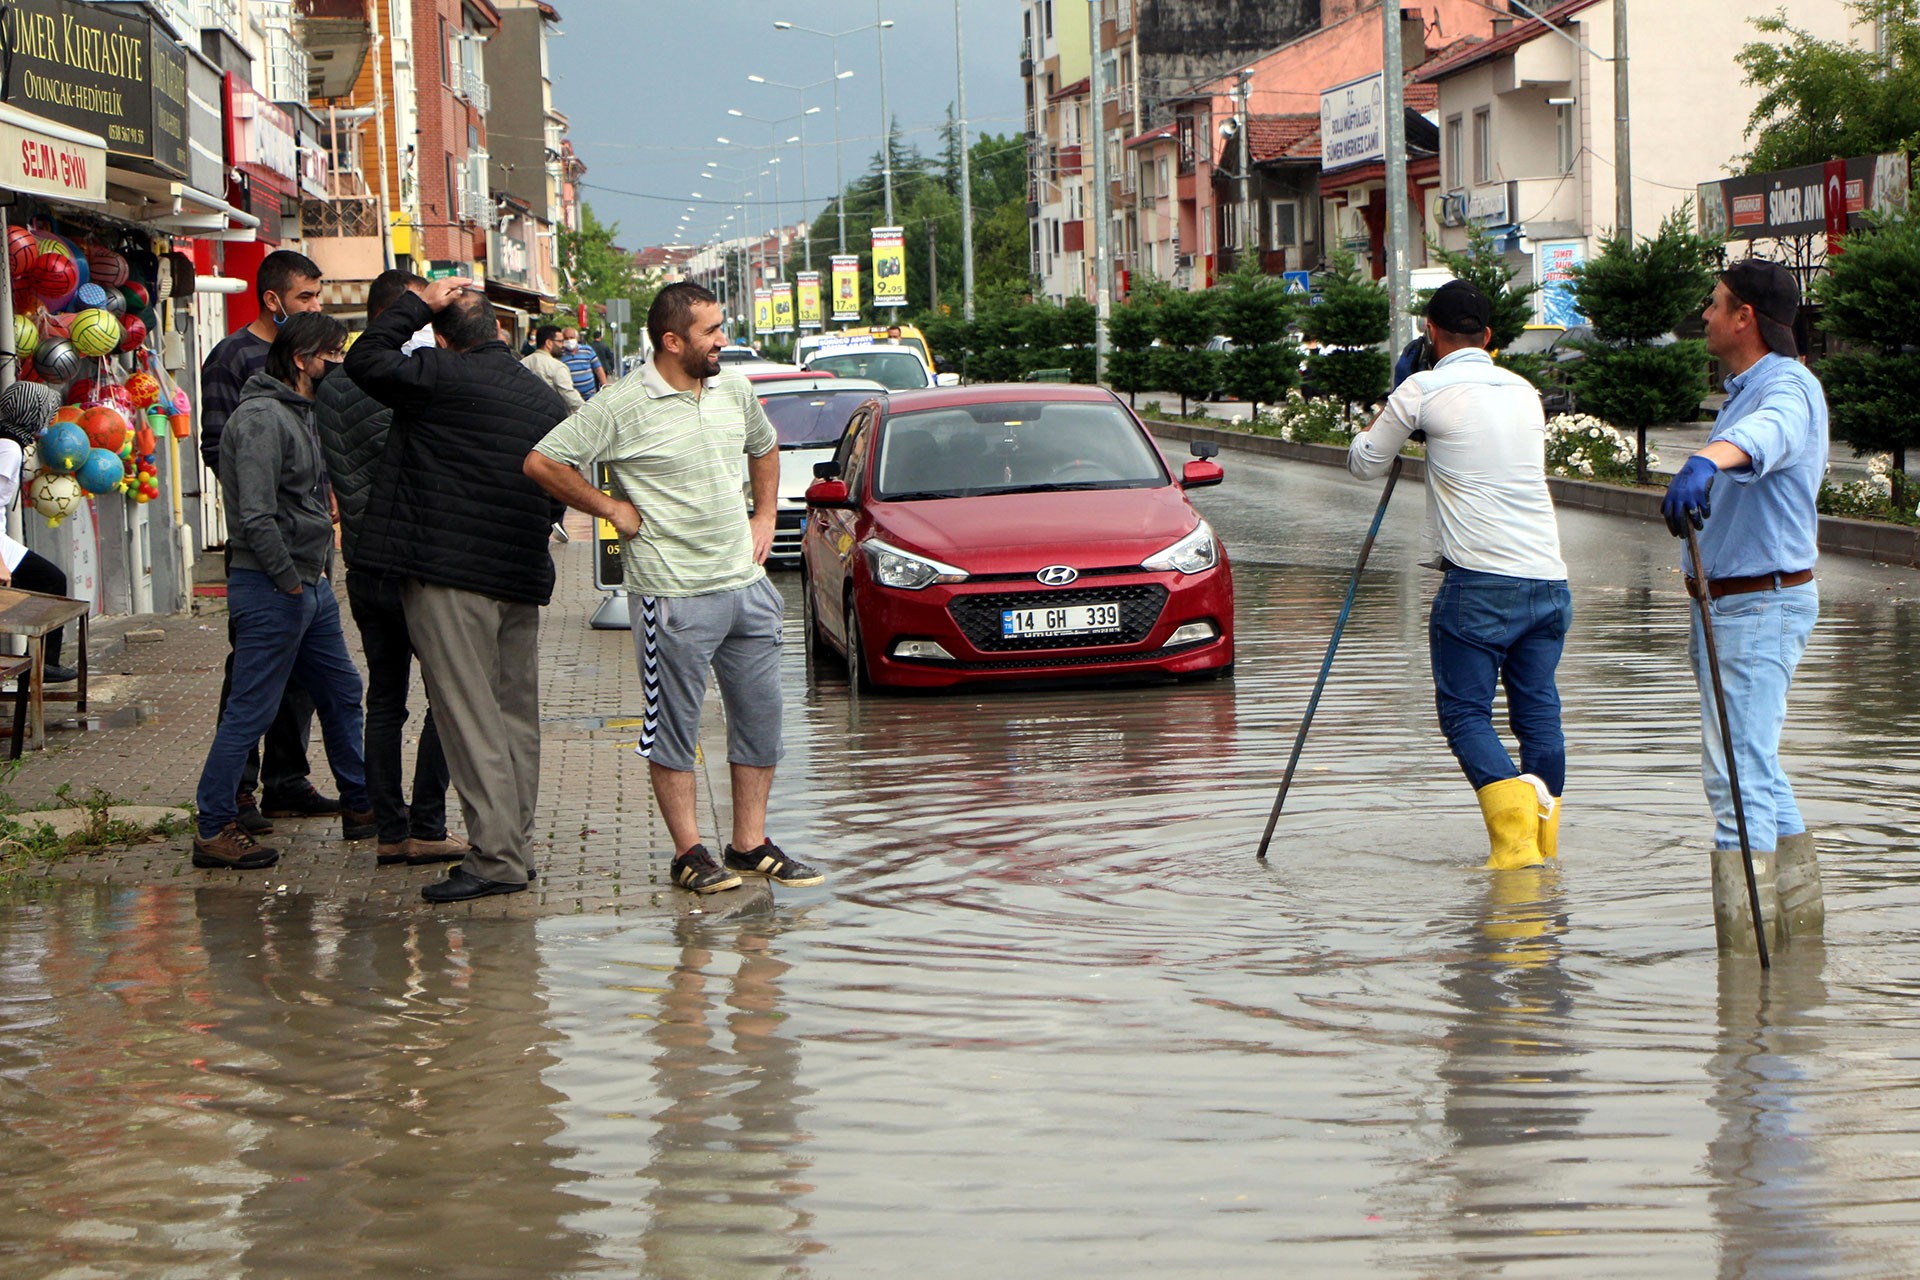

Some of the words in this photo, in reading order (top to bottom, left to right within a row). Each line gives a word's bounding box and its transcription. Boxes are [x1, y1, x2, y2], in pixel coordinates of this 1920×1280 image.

[62, 13, 143, 82] KIRTASİYE
[24, 69, 124, 117] OYUNCAK-HEDİYELİK
[1331, 118, 1344, 135] BOLU
[22, 139, 59, 182] SELMA
[1326, 139, 1343, 162] SÜMER
[1343, 135, 1364, 157] MERKEZ
[1769, 182, 1801, 225] SÜMER
[877, 281, 903, 293] 9.95
[835, 300, 857, 311] 17.95
[1016, 612, 1034, 630] 14
[1047, 610, 1066, 628] GH
[1087, 607, 1116, 625] 339
